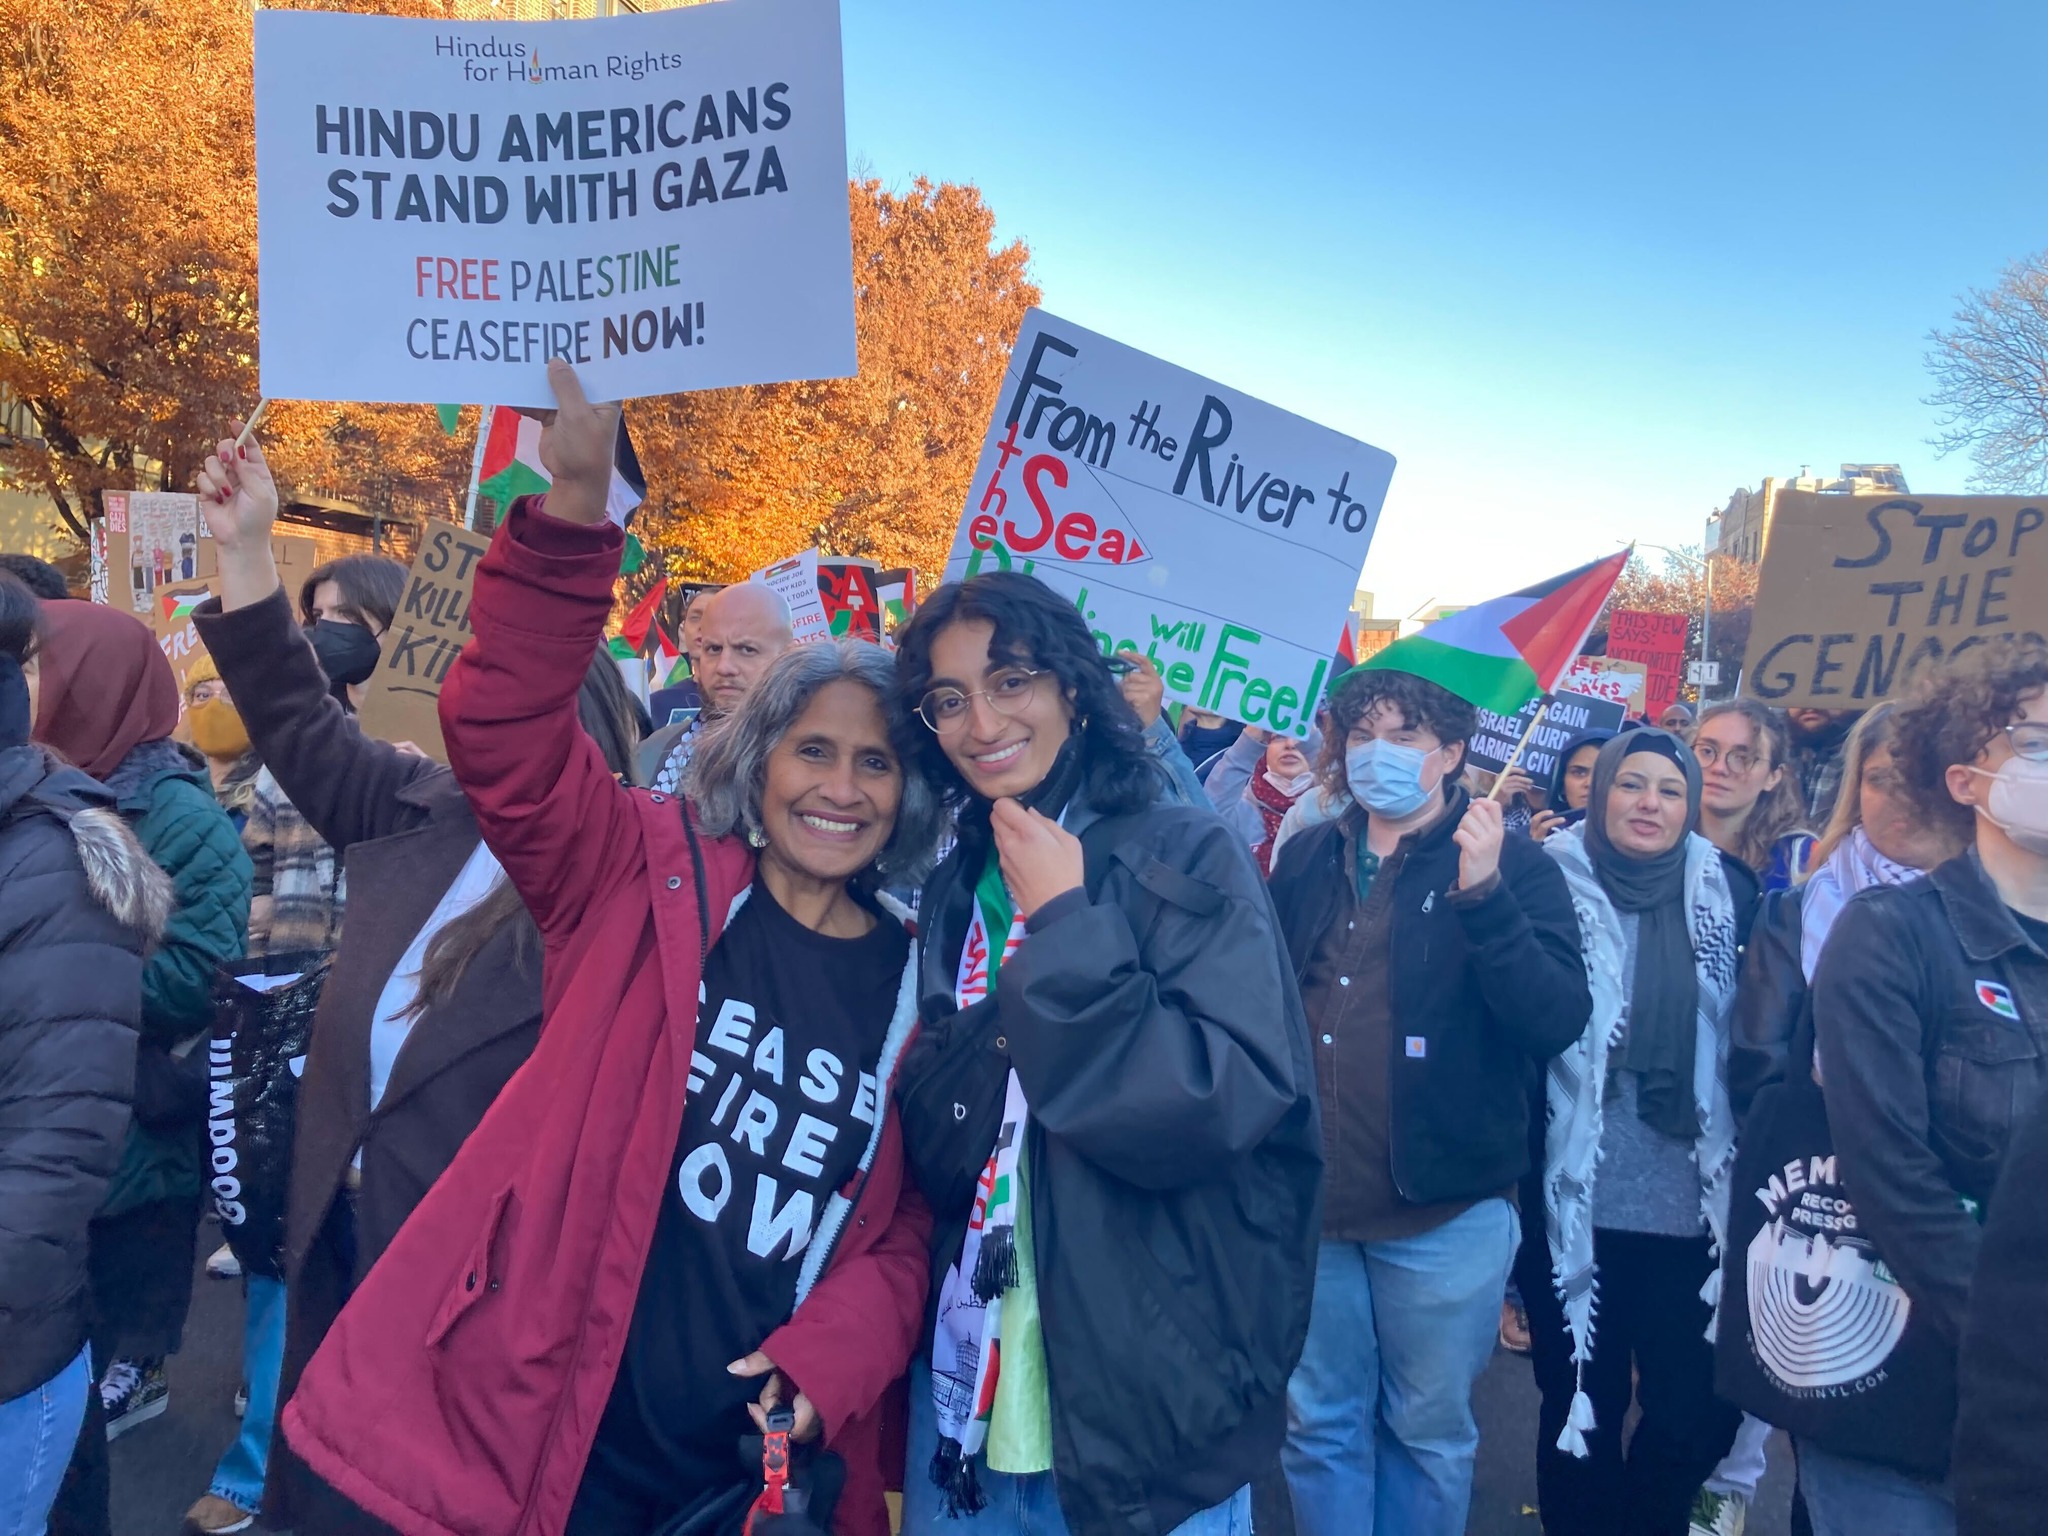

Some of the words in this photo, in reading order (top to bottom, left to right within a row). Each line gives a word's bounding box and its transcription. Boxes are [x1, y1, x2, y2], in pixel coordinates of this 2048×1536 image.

[435, 35, 526, 58] Hindus
[463, 60, 498, 82] for
[507, 58, 598, 84] Human
[608, 52, 682, 80] Rights
[315, 104, 480, 162] HINDU
[498, 82, 792, 163] AMERICANS
[326, 169, 509, 224] STAND
[525, 168, 637, 224] WITH
[653, 145, 789, 212] GAZA
[415, 256, 500, 301] FREE
[511, 244, 681, 303] PALESTINE
[406, 318, 591, 364] CEASEFIRE
[602, 301, 705, 359] NOW!
[1005, 331, 1116, 469] From
[1128, 400, 1178, 461] the
[1172, 395, 1315, 528] River
[1327, 471, 1367, 533] to
[1003, 454, 1126, 565] Sea
[1832, 499, 2046, 568] STOP
[424, 531, 486, 580] ST
[790, 579, 807, 590] KIDS
[791, 570, 804, 579] JOE
[792, 588, 814, 600] TODAY
[1616, 612, 1648, 629] THIS
[1651, 616, 1686, 634] JEW
[1867, 565, 2014, 627] THE
[1612, 627, 1656, 645] SAYS:
[1150, 613, 1206, 653] will
[1196, 623, 1328, 737] Free!
[1470, 733, 1525, 766] NARMED
[698, 981, 877, 1126] EASE
[679, 1143, 813, 1261] OW
